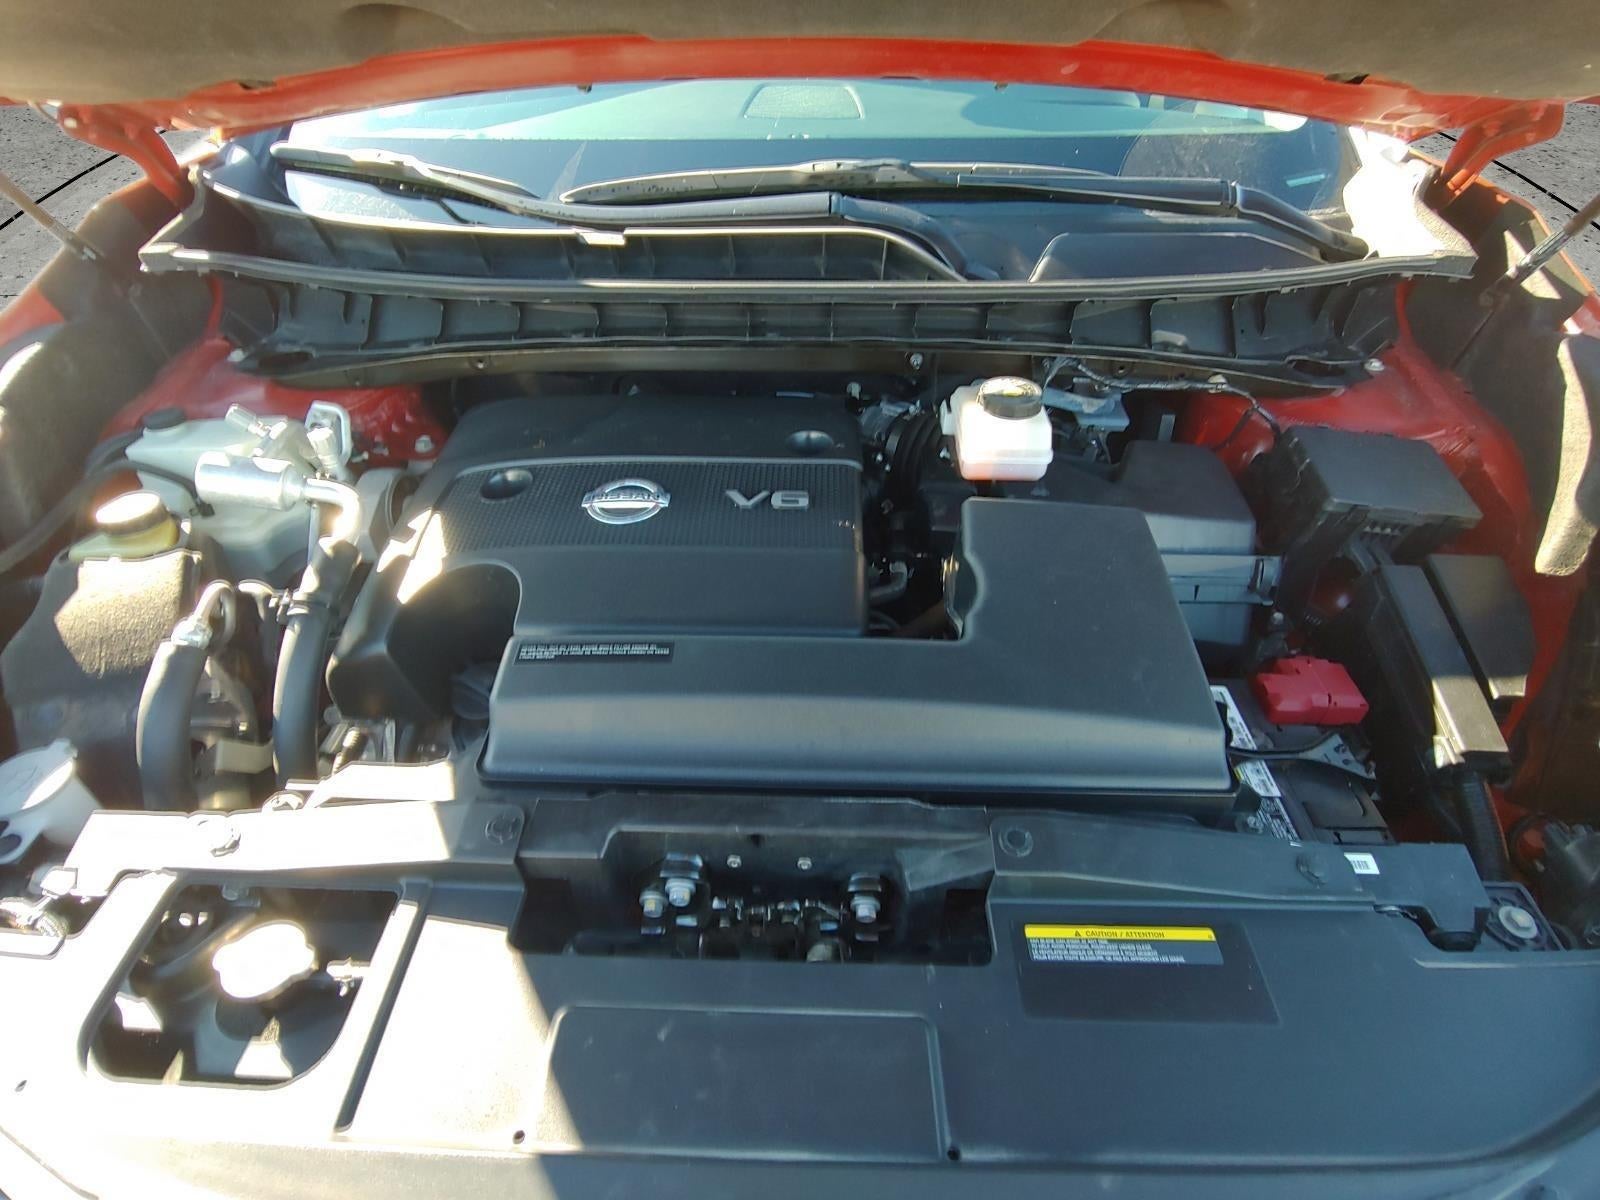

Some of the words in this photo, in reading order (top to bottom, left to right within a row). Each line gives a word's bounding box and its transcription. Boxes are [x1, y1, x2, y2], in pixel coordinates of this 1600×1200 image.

[725, 490, 809, 510] V6
[1085, 929, 1118, 938] CAUTION
[1125, 930, 1166, 939] ATTENTION
